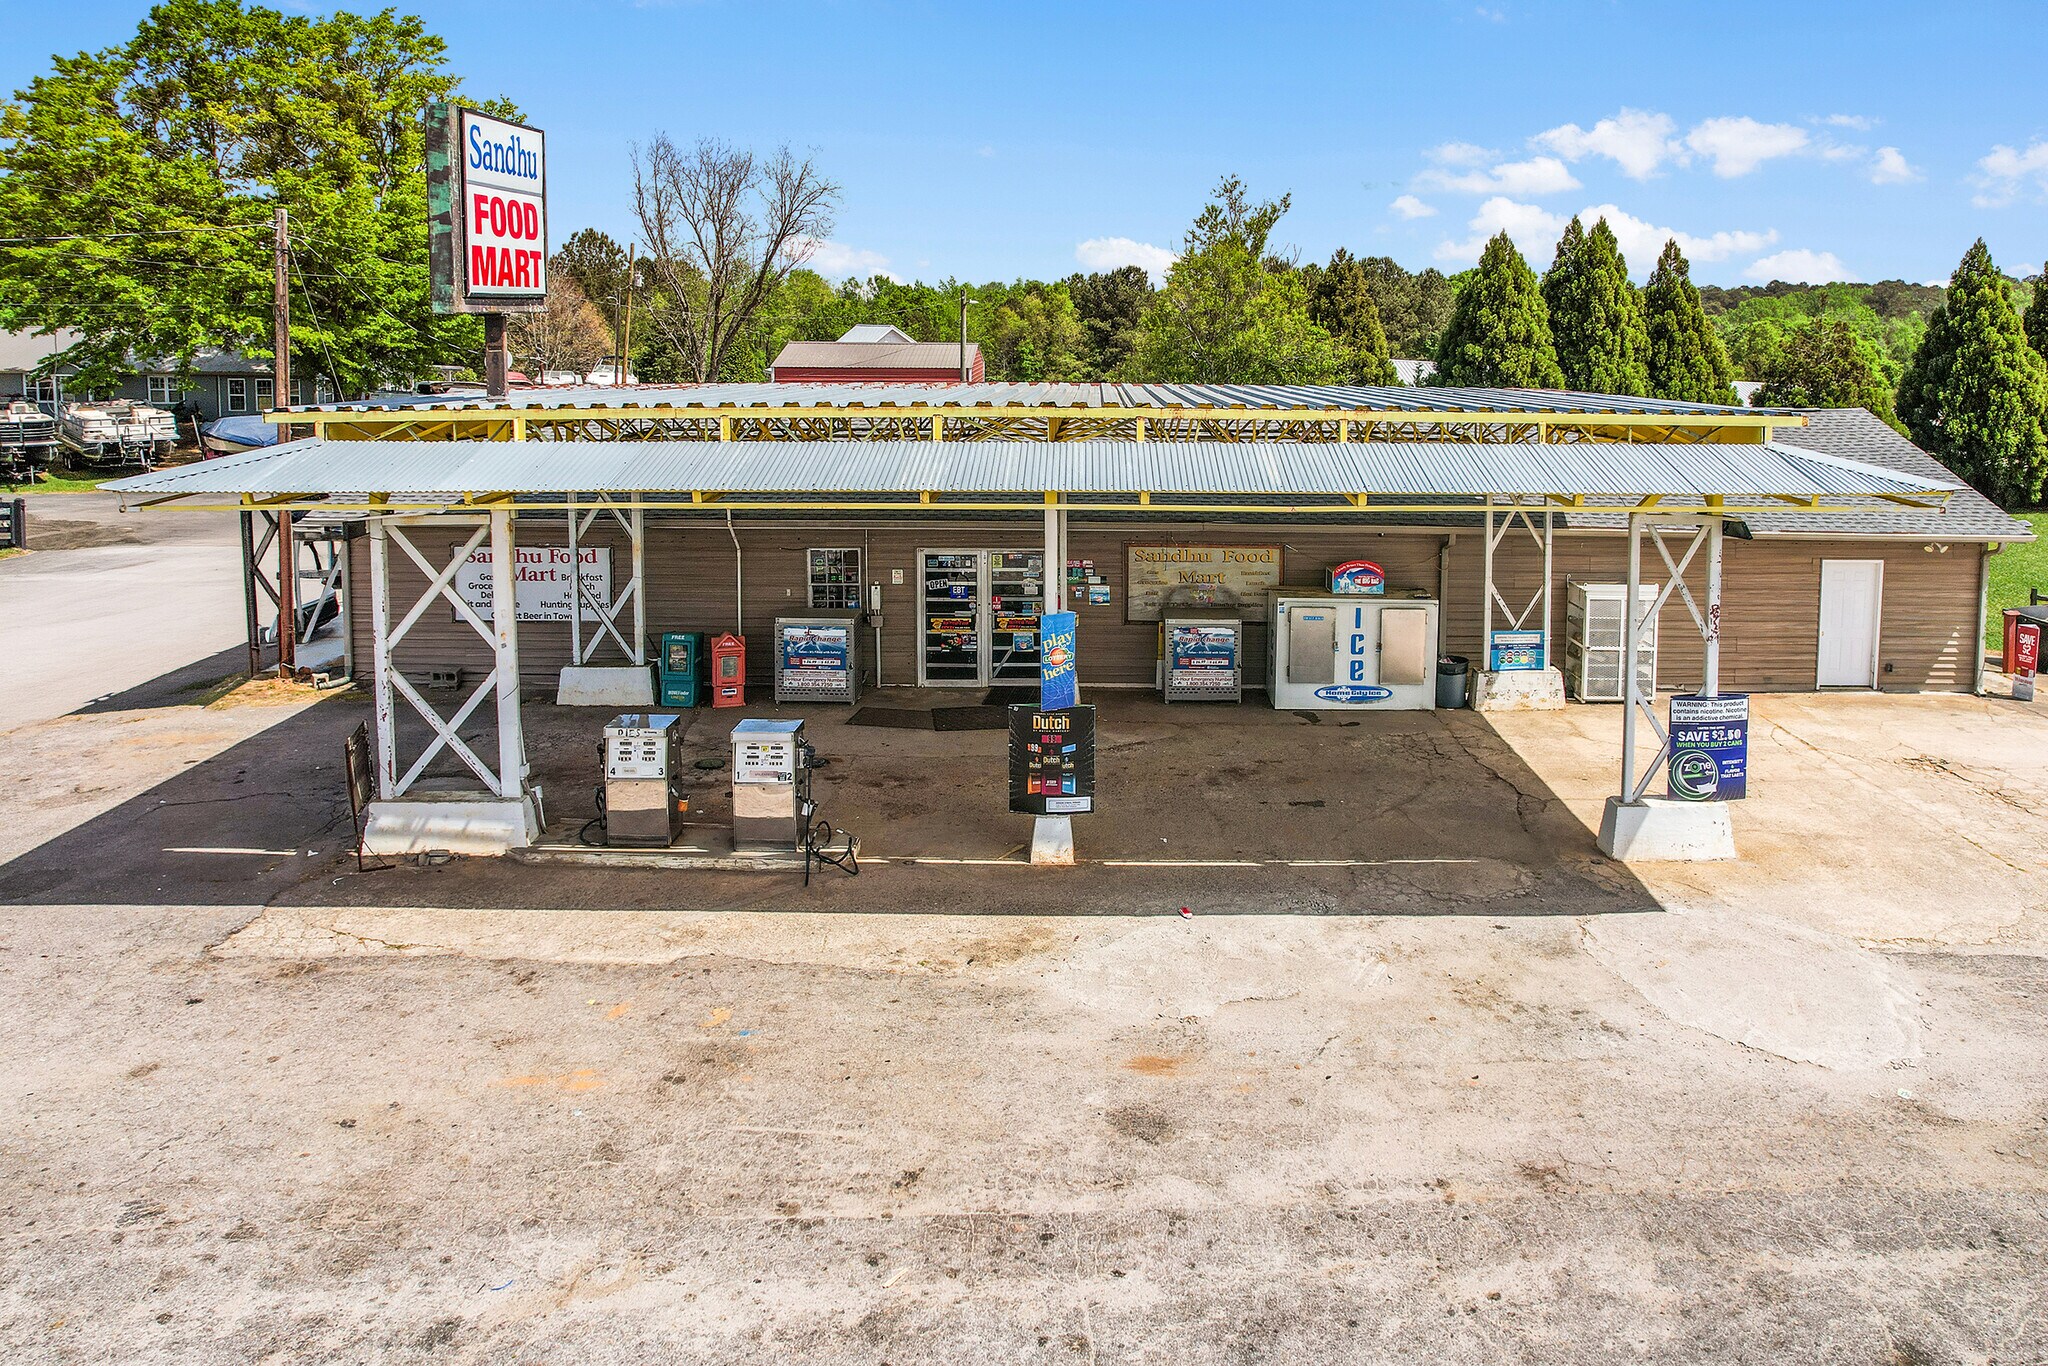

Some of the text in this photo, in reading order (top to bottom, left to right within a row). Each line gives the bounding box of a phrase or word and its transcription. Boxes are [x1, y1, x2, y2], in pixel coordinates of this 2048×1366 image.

[469, 124, 538, 181] Sandhu
[473, 192, 539, 241] FOOD
[471, 244, 542, 289] MART
[466, 548, 543, 564] Sahu
[1134, 548, 1275, 564] Sandhu Food
[561, 573, 603, 582] Brkfast
[1178, 570, 1227, 584] Mart
[930, 580, 948, 589] OPEN
[475, 600, 491, 608] and
[524, 612, 542, 620] Beer
[544, 612, 552, 620] in
[1042, 631, 1073, 653] play
[2020, 633, 2036, 646] SAVE
[2022, 644, 2032, 655] $2
[1042, 661, 1074, 681] here
[1033, 715, 1070, 729] Dutch
[1678, 731, 1710, 742] SAVE
